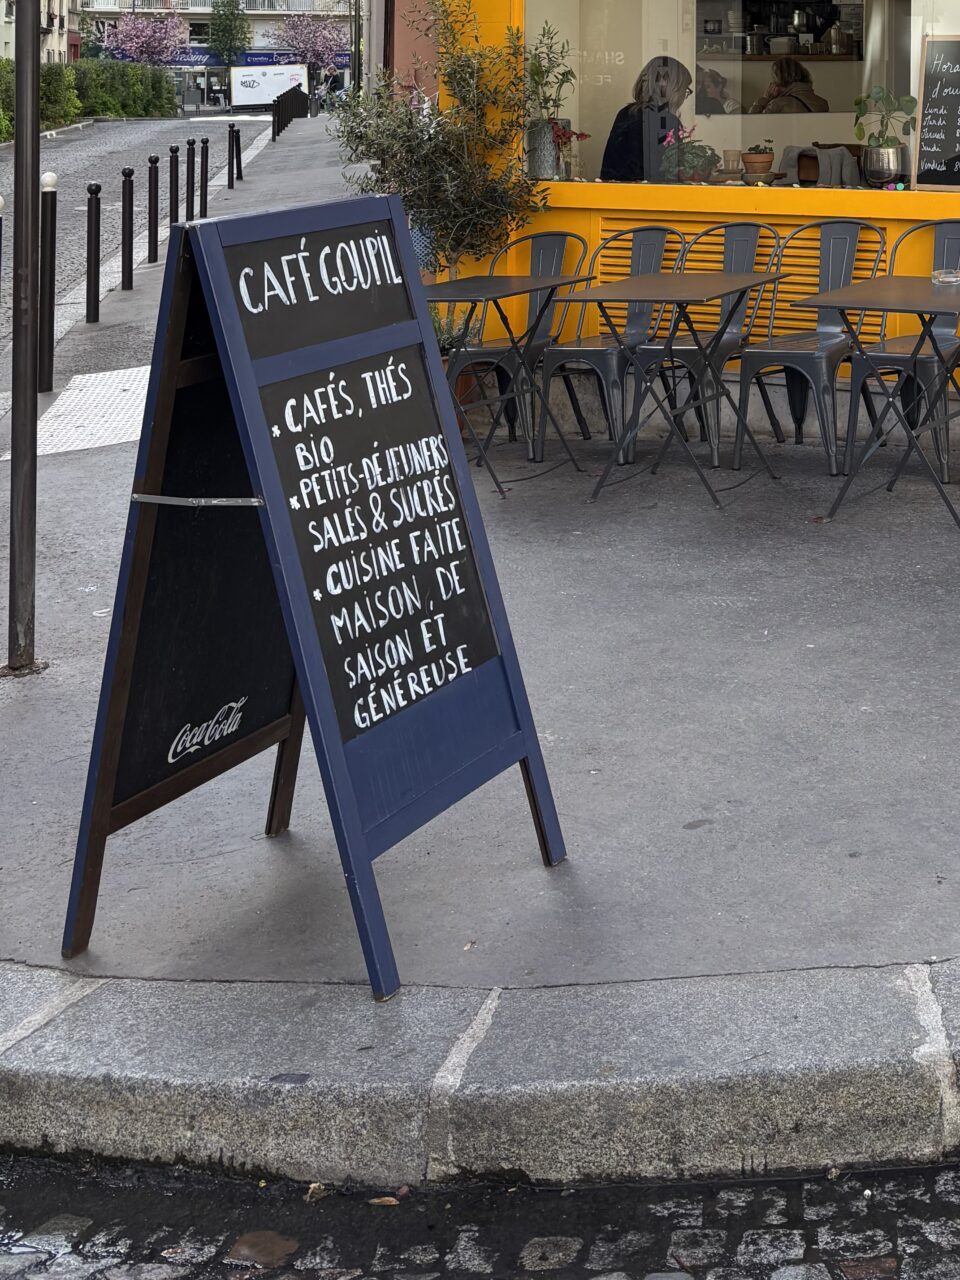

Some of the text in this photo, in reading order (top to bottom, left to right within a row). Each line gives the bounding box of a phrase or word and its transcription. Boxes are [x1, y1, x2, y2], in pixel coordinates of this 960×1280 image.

[921, 142, 941, 152] Jeudi
[923, 115, 946, 126] Mardi
[924, 103, 948, 115] Lundi
[239, 229, 402, 314] CAFÉ GOUPIL
[284, 356, 413, 434] CAFÉS, THÉS
[295, 434, 335, 471] BIO
[299, 433, 450, 509] PETITS-DÉJEUNERS
[308, 470, 456, 552] SALÉS & SUCRÉS
[326, 517, 467, 595] CUISINE FAITE
[435, 560, 466, 601] DE
[344, 612, 447, 689] SAISON ET
[353, 644, 472, 729] GÉNÉREUSE
[167, 695, 248, 763] Coca-Cola
